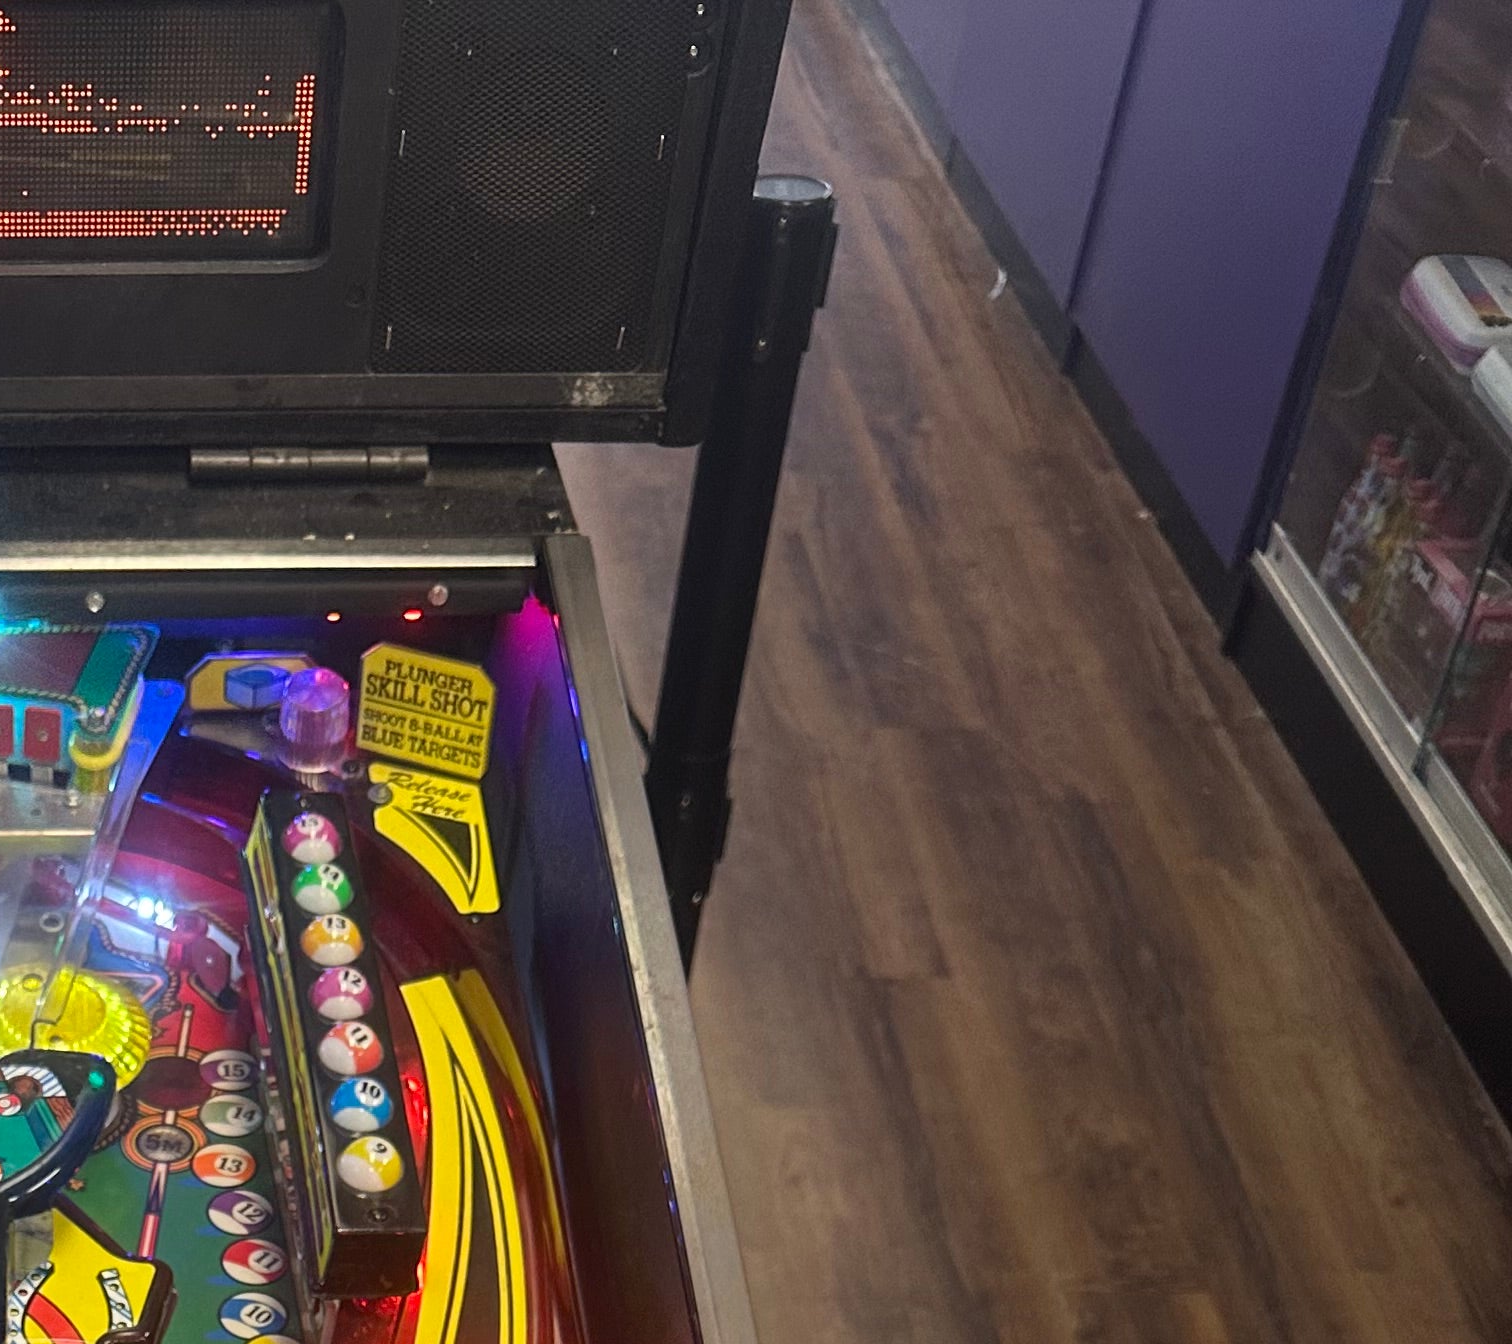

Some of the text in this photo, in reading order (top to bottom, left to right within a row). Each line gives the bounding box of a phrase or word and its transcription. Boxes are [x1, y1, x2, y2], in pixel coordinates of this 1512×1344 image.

[386, 661, 472, 692] PLUNGER
[366, 675, 488, 721] SKILL SHOT
[363, 708, 483, 746] SHOOT 8-BALL AT
[362, 729, 481, 768] BLUE TARGETS
[388, 772, 472, 803] Release
[412, 795, 464, 819] Here
[223, 1064, 244, 1077] 15
[233, 1108, 255, 1122] 14
[220, 1158, 242, 1172] 13
[237, 1204, 263, 1221] 12
[255, 1252, 278, 1270] 11
[248, 1307, 272, 1323] 10
